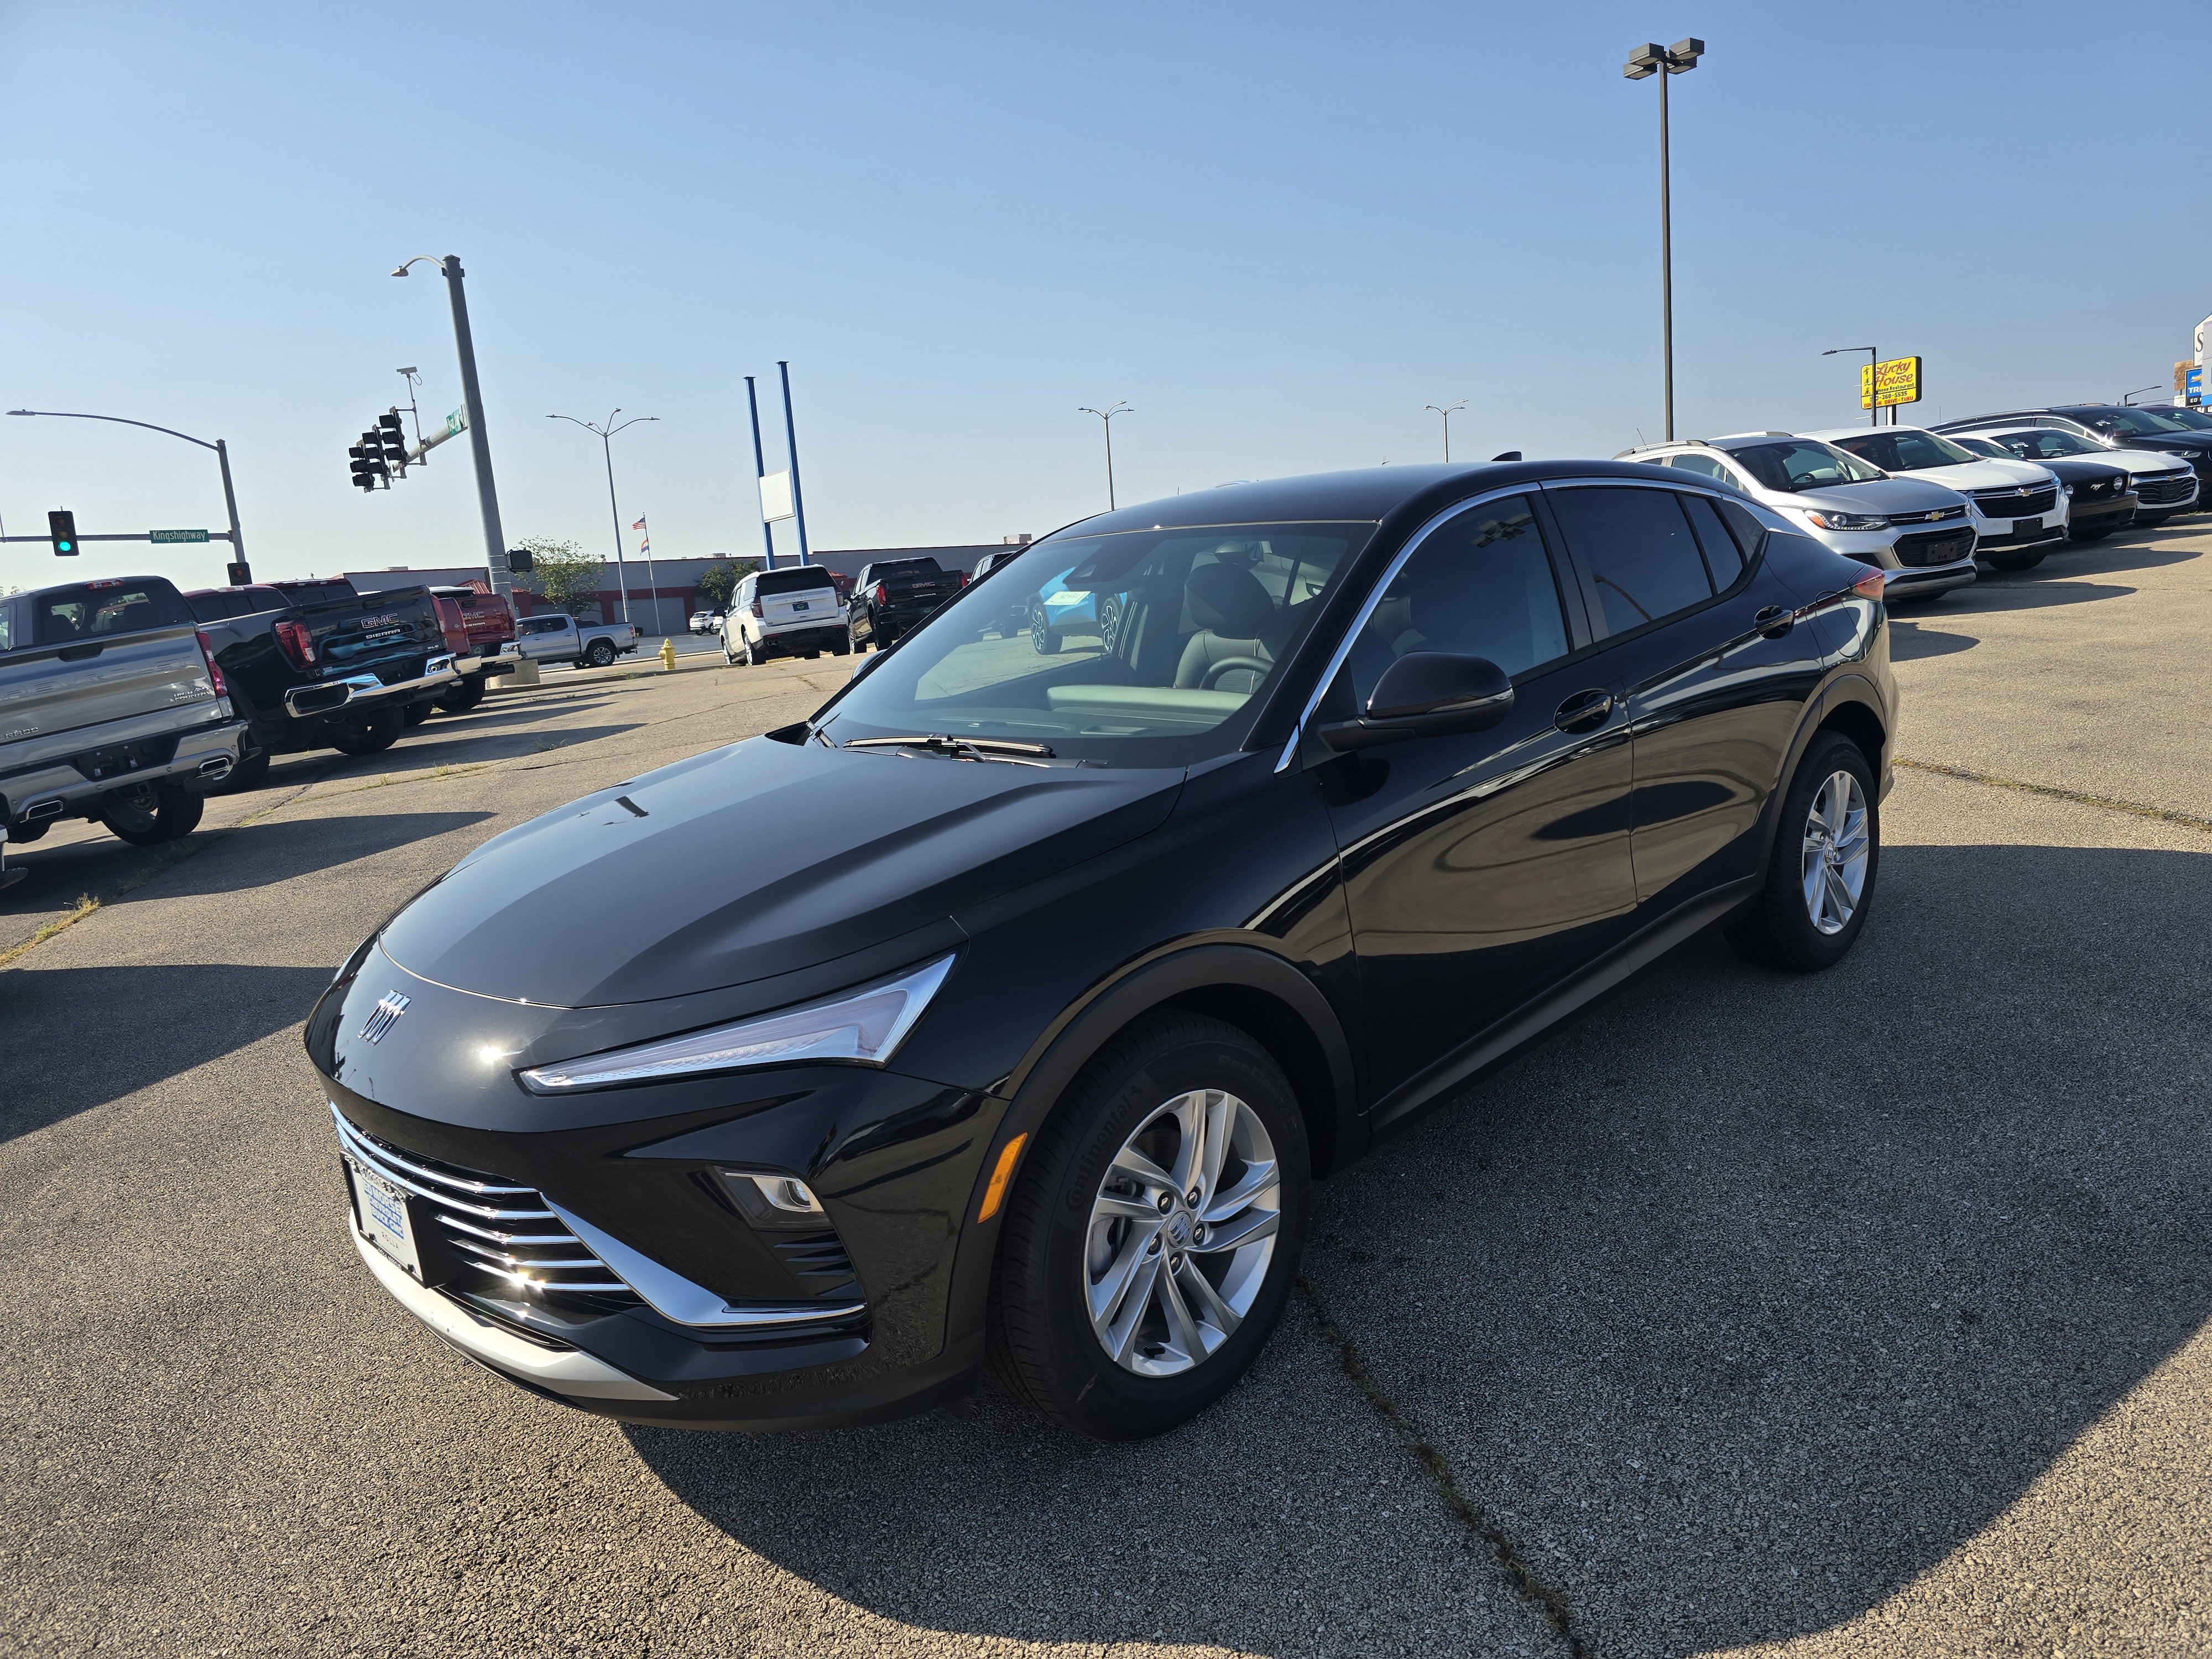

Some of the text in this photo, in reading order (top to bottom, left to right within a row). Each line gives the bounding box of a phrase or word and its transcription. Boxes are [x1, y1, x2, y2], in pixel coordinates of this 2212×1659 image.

[1876, 361, 1912, 375] Lucky
[1875, 373, 1913, 388] House
[1885, 395, 1913, 405] DRIVE-THRU
[153, 530, 205, 542] Kingshighway
[361, 613, 399, 629] GMC
[366, 629, 400, 639] SIERRA
[1065, 1094, 1135, 1213] Continental
[372, 1186, 402, 1217] MORSE
[369, 1196, 402, 1225] CHEVROLET
[381, 1231, 400, 1250] ROLLA
